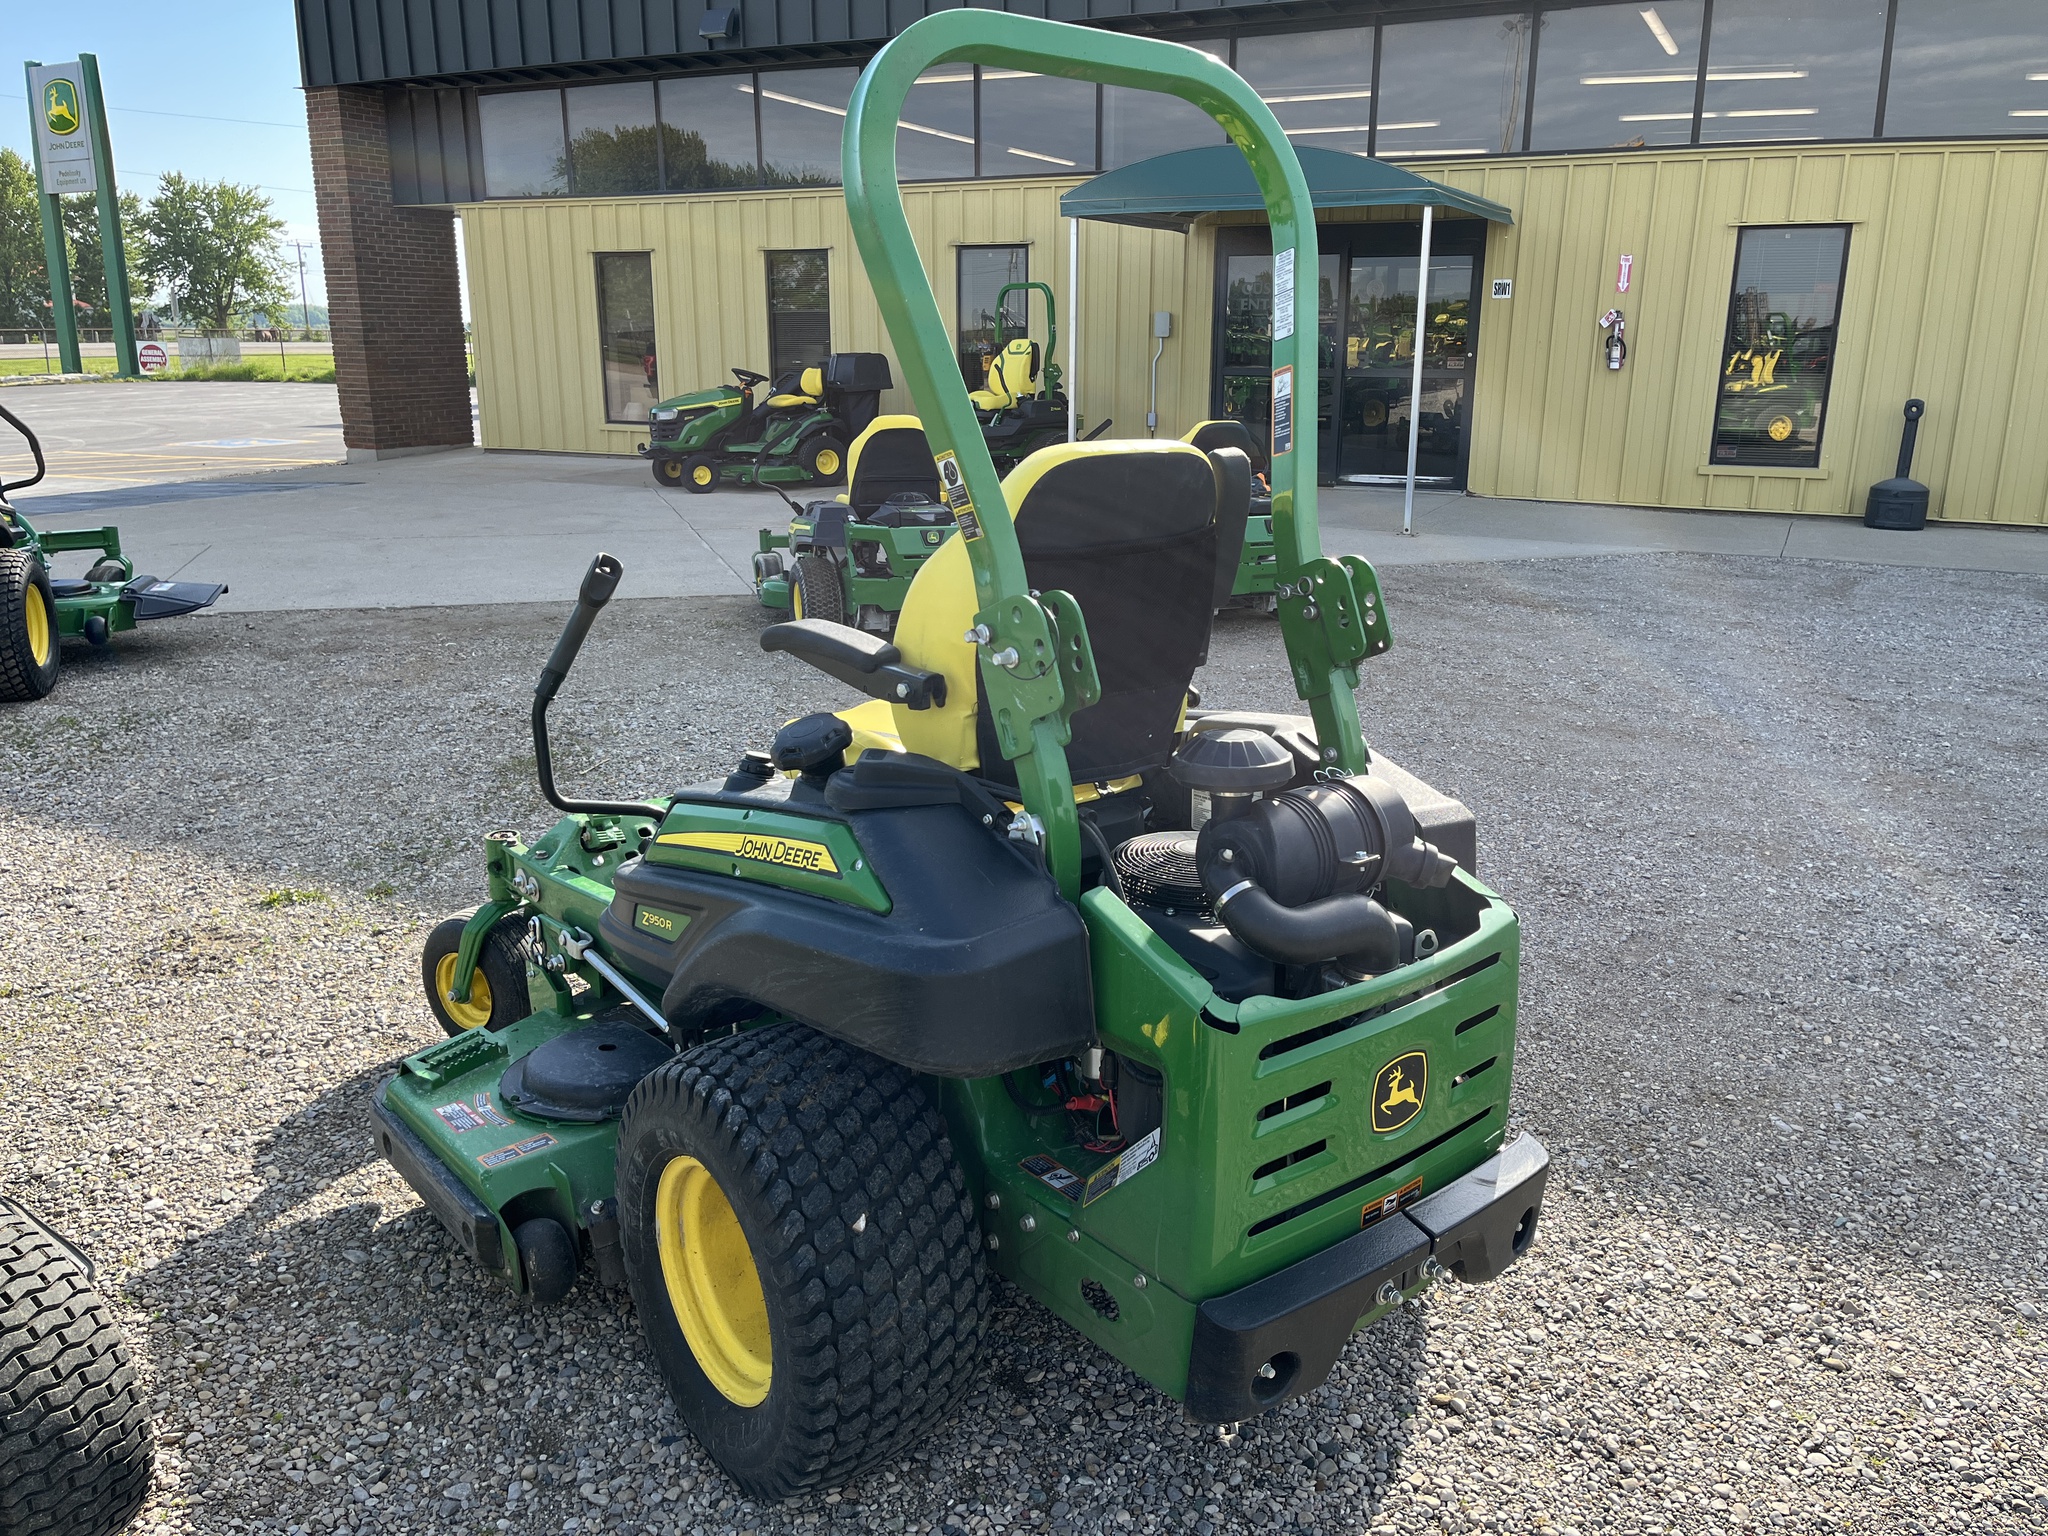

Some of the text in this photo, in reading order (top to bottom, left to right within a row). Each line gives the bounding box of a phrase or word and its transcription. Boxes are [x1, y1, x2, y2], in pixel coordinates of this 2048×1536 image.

[49, 140, 85, 151] JOHN DEERE
[1493, 282, 1511, 296] SRW1
[735, 835, 822, 868] JOHN DEERE
[642, 911, 672, 931] Z950R
